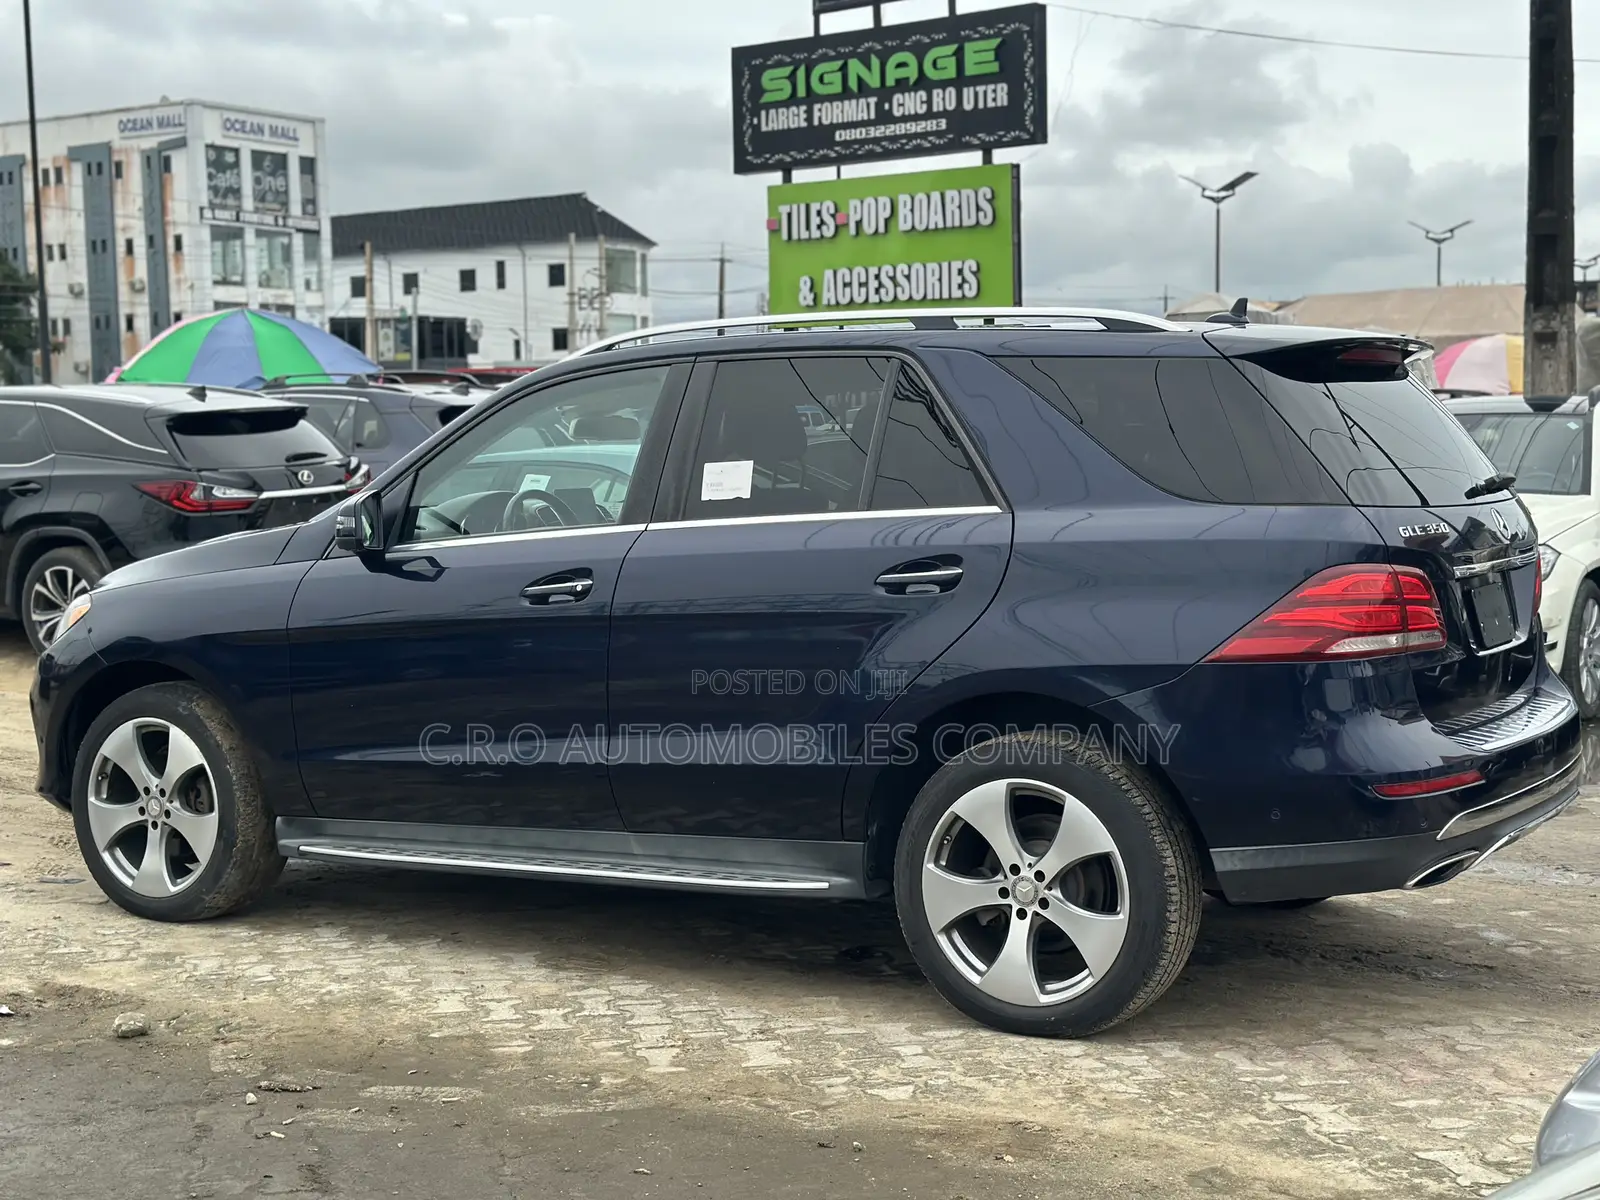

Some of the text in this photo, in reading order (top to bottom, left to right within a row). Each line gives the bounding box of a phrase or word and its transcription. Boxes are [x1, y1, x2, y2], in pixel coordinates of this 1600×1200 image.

[759, 38, 1002, 103] SIGNAGE
[118, 113, 185, 133] OCEAN MALL
[223, 117, 300, 142] OCEAN MALL
[760, 104, 808, 132] LARGE
[813, 97, 878, 126] FORMAT
[892, 89, 929, 117] CNC
[778, 186, 994, 241] TILES POP BOARDS
[798, 259, 980, 307] & ACCESSORIES
[1398, 522, 1450, 537] GLE 350
